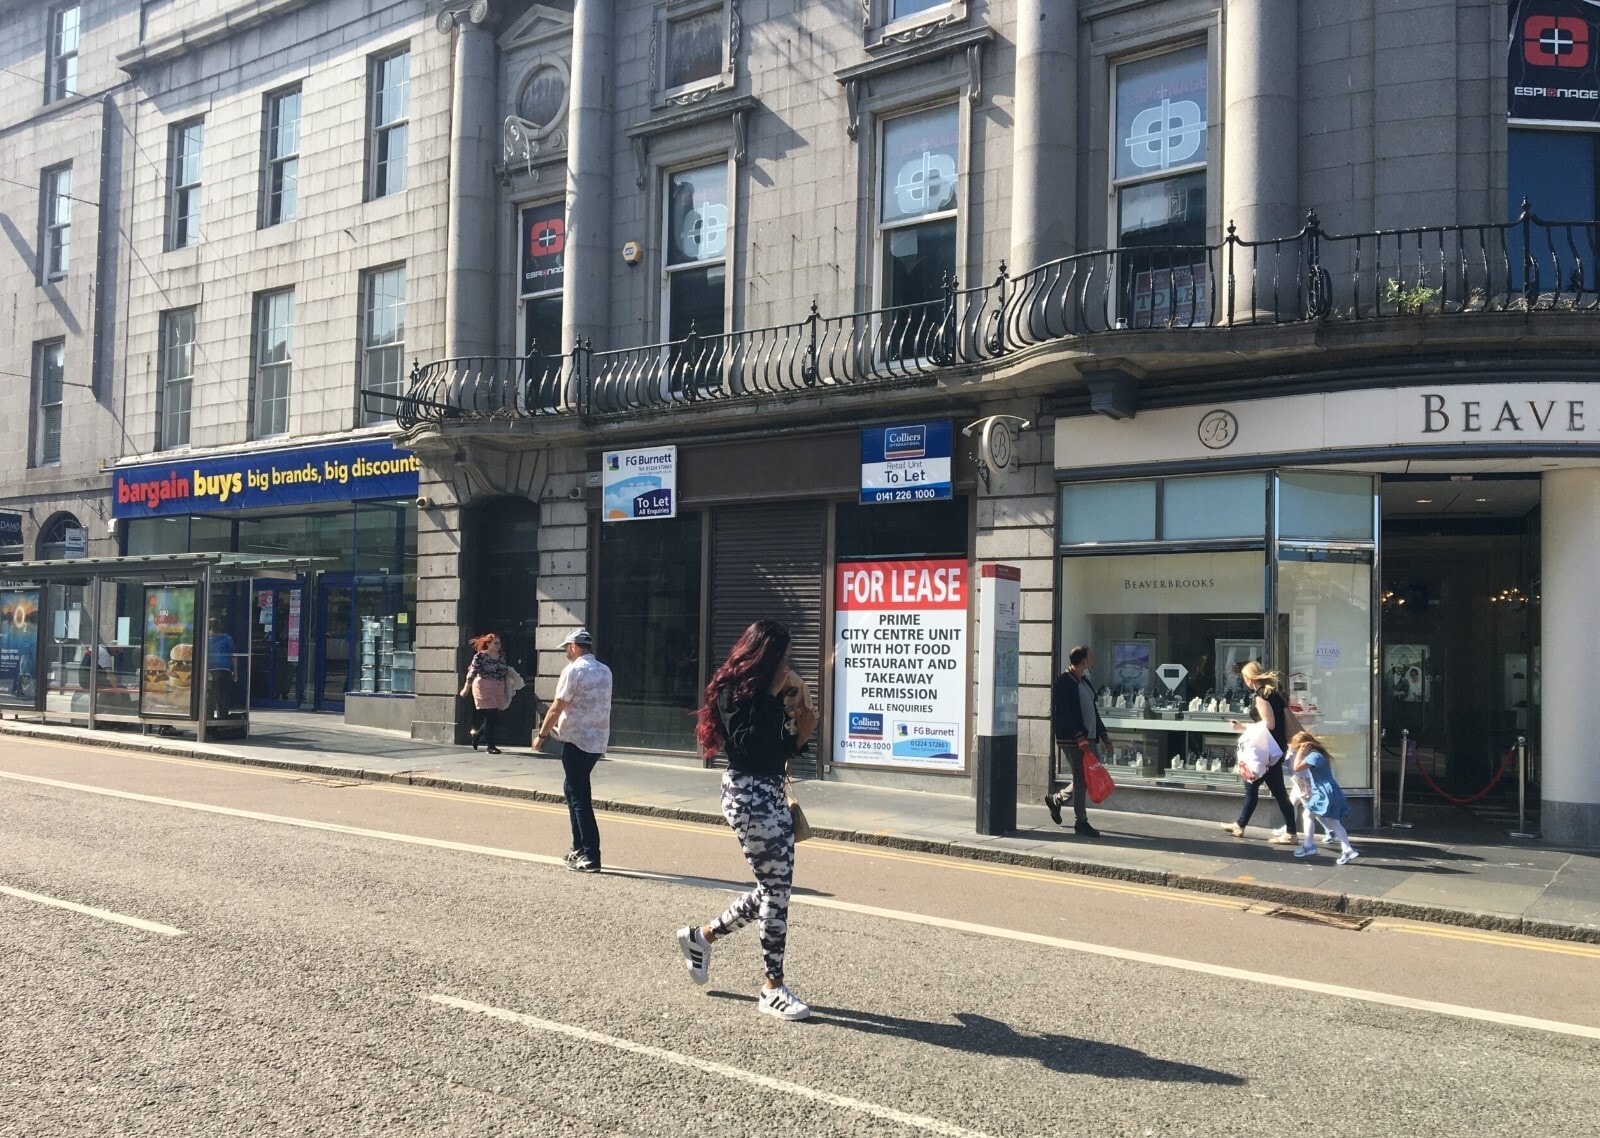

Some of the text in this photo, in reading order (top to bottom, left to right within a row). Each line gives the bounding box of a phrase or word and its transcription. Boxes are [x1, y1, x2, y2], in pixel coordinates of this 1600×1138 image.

[1514, 87, 1599, 99] ESPIONAGE
[526, 266, 565, 279] ESPIONAG
[1421, 394, 1600, 433] BEAVE
[889, 433, 921, 443] Colliers
[625, 453, 672, 466] FG Burnett
[886, 460, 922, 470] Retail Unit
[884, 470, 926, 483] To Let
[118, 471, 189, 508] bargain
[193, 470, 243, 501] buys
[247, 469, 269, 490] big
[271, 464, 322, 485] brands,
[325, 461, 349, 483] big
[876, 489, 935, 501] 0141 226 1000
[637, 496, 670, 508] To Let
[647, 507, 670, 516] Enquiries
[843, 568, 960, 603] FOR LEASE
[1124, 579, 1214, 589] BEAVERBROOKS
[879, 614, 920, 625] PRIME
[841, 629, 961, 640] CITY CENTRE UNIT
[851, 643, 951, 655] WITH HOT FOOD
[844, 658, 957, 670] RESTAURANT AND
[865, 673, 934, 684] TAKEAWAY
[861, 687, 937, 700] PERMISSION
[868, 703, 933, 713] ALL ENQUIRIES
[851, 716, 880, 727] Colliers
[913, 727, 954, 736] FG Burnett
[840, 740, 891, 750] 0141 226 1000
